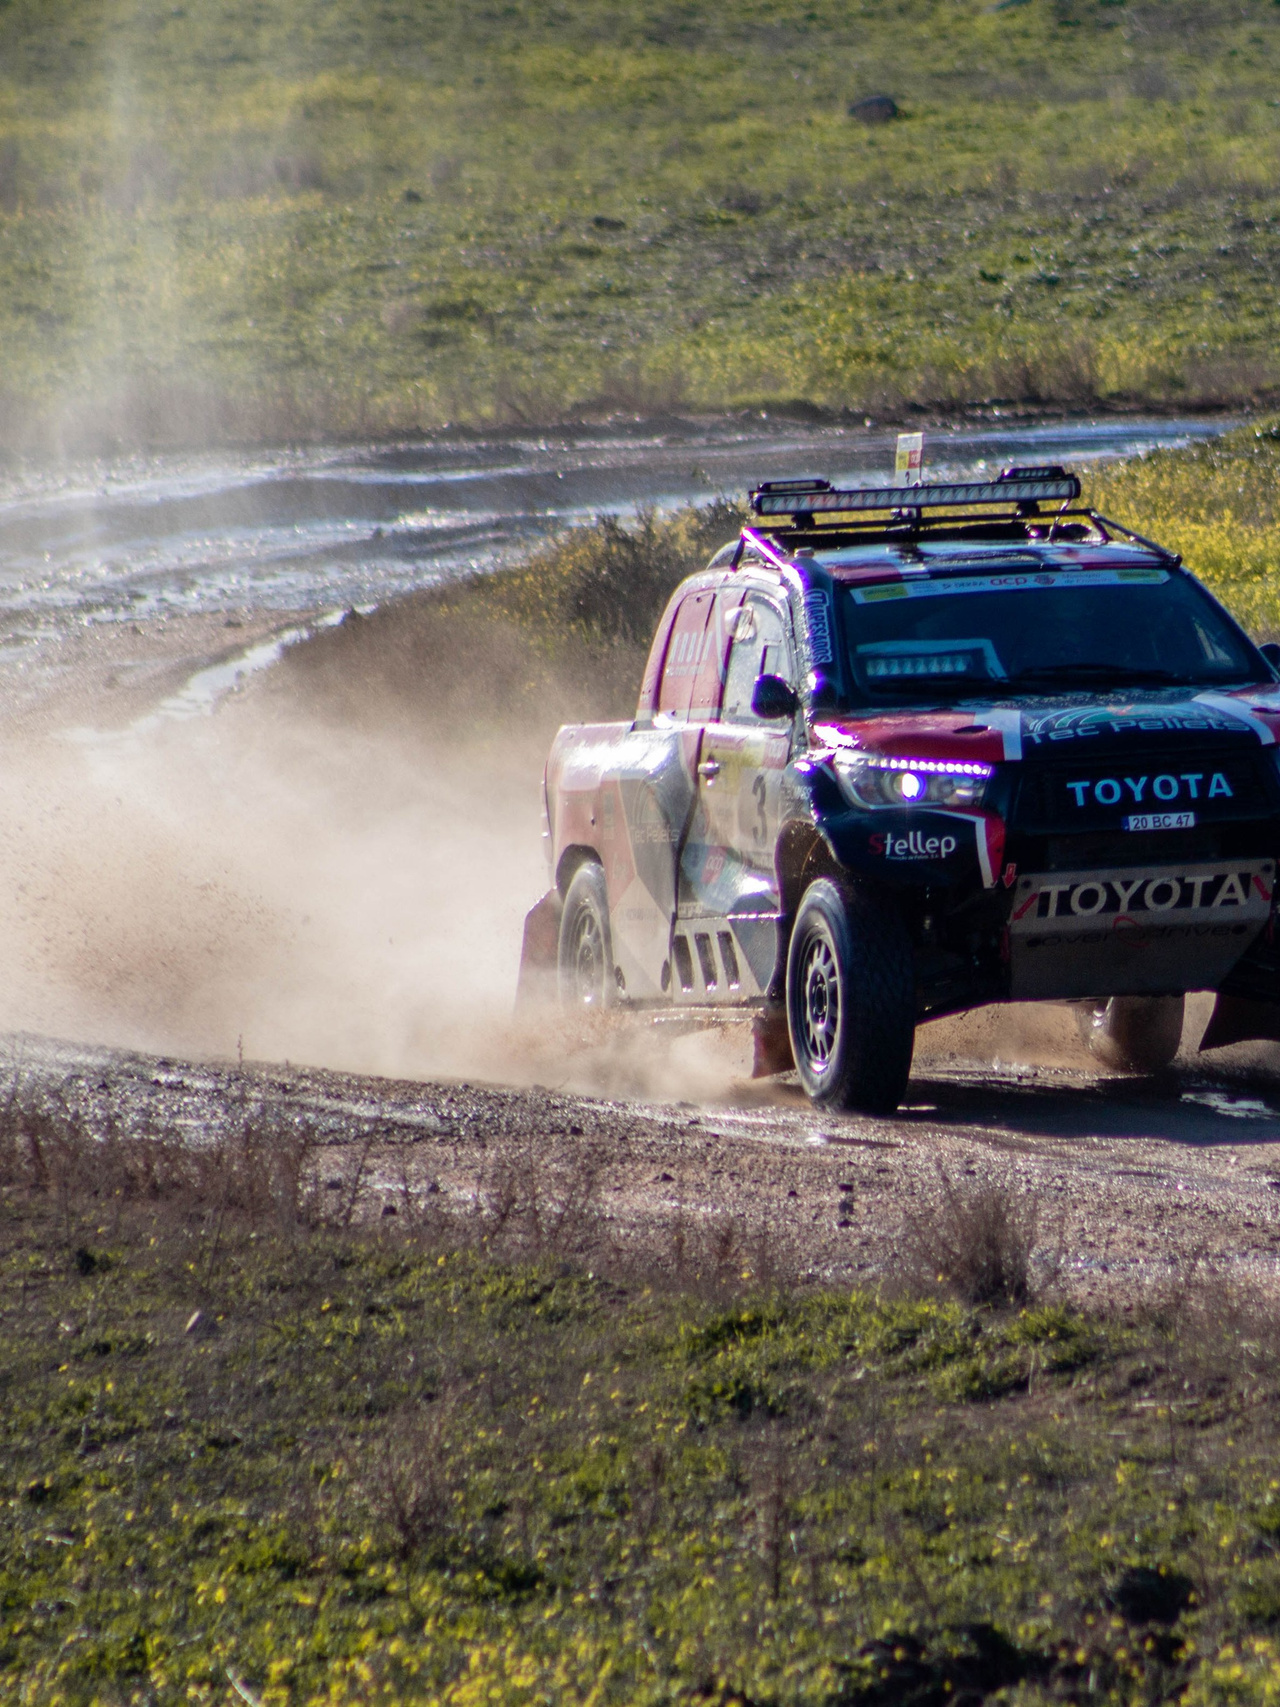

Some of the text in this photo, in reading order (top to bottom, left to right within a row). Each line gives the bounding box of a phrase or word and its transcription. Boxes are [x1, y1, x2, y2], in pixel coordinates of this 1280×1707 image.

[990, 576, 1027, 587] acp
[1023, 717, 1250, 744] Tec Pellets
[1066, 773, 1234, 807] TOYOTA
[1132, 814, 1190, 829] 20 BC 47
[869, 831, 956, 858] Stellep
[1039, 873, 1248, 918] TOYOTA
